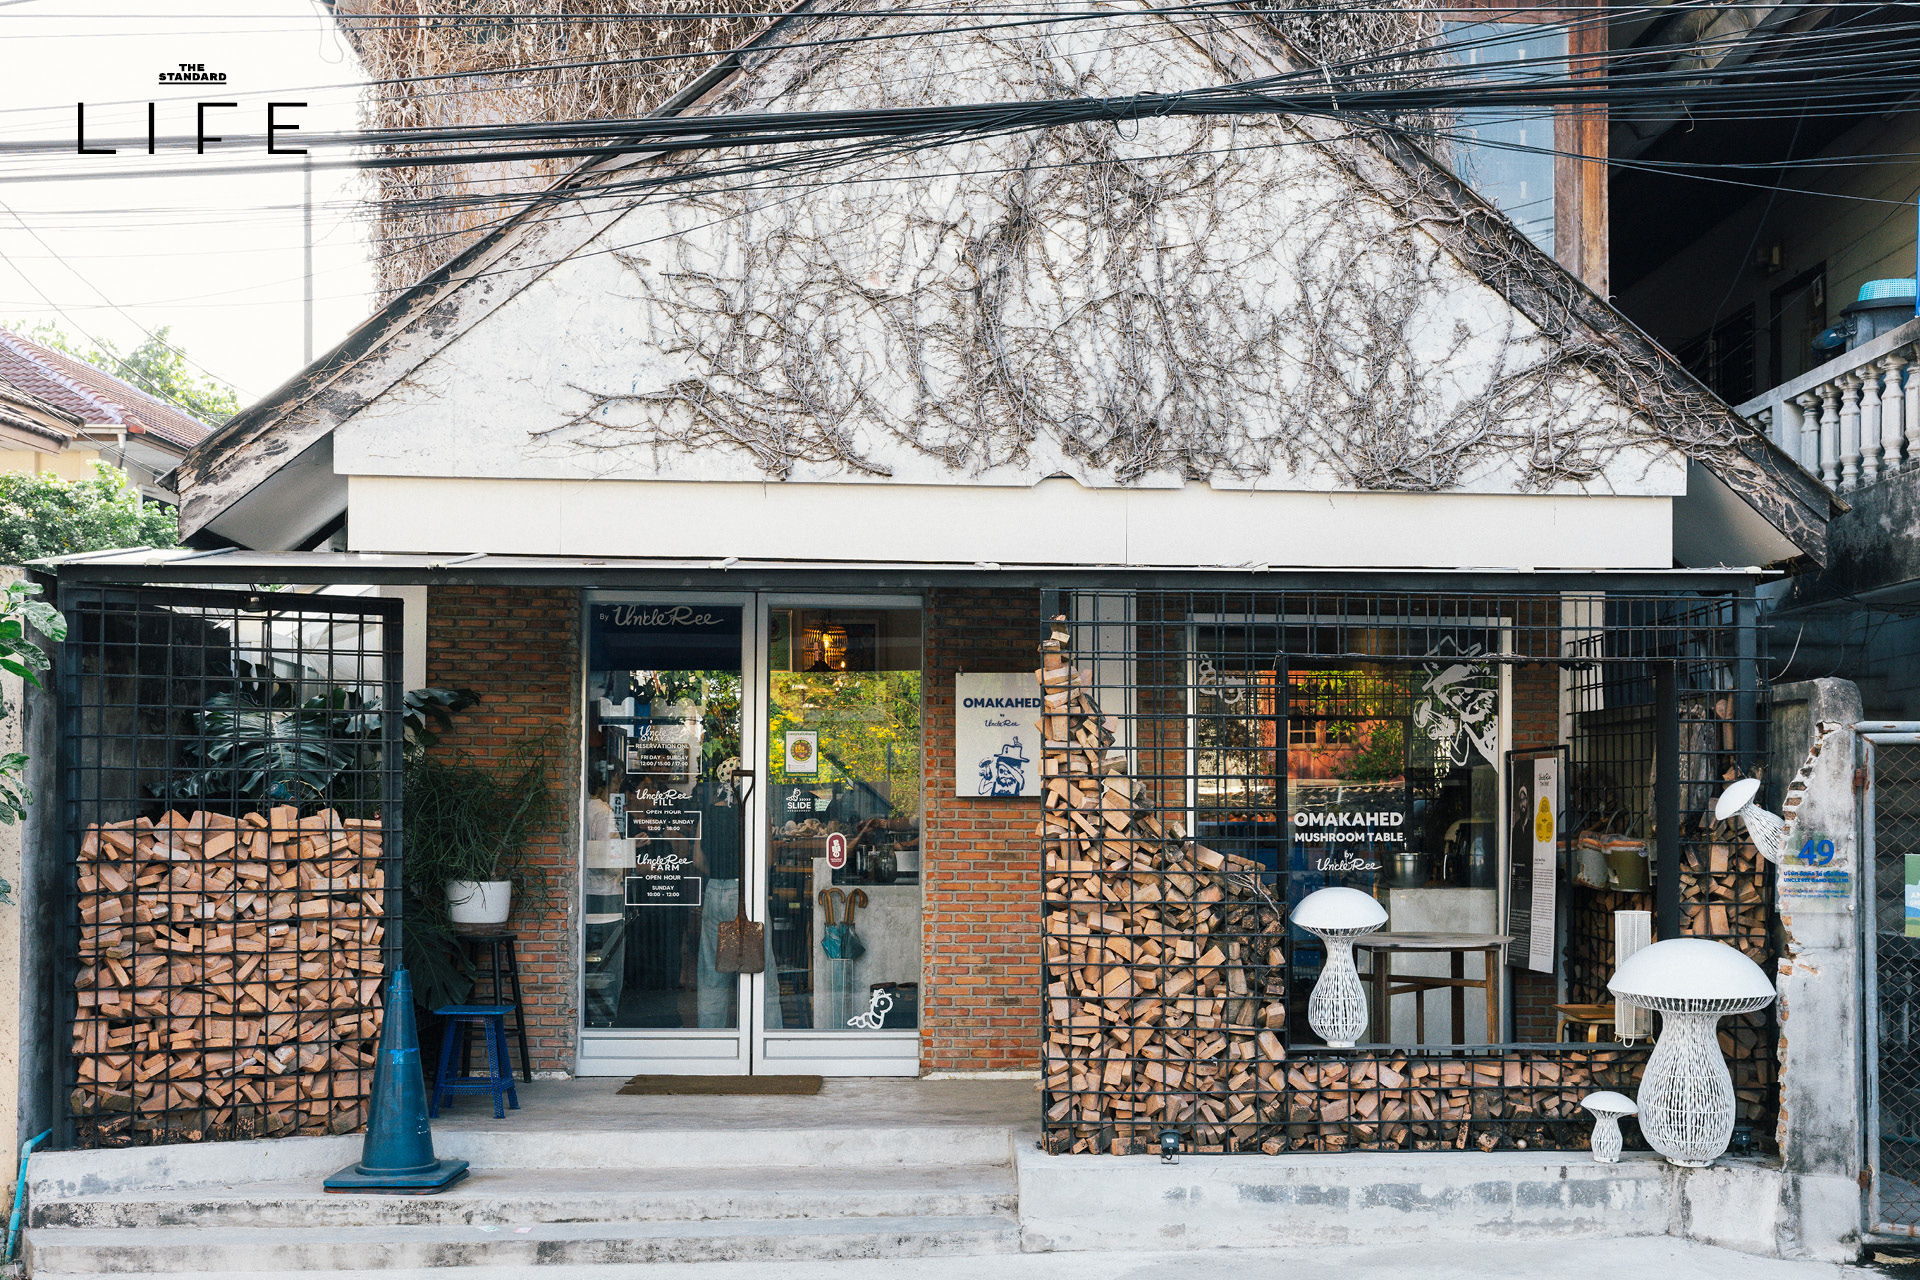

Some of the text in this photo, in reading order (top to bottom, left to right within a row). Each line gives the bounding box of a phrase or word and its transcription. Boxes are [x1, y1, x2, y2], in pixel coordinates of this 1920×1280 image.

[600, 613, 609, 621] By
[963, 698, 1041, 708] OMAKAHED
[1294, 812, 1403, 827] OMAKAHED
[1295, 832, 1403, 842] MUSHROOM TABLE
[1344, 850, 1354, 859] by
[1798, 839, 1834, 866] 49
